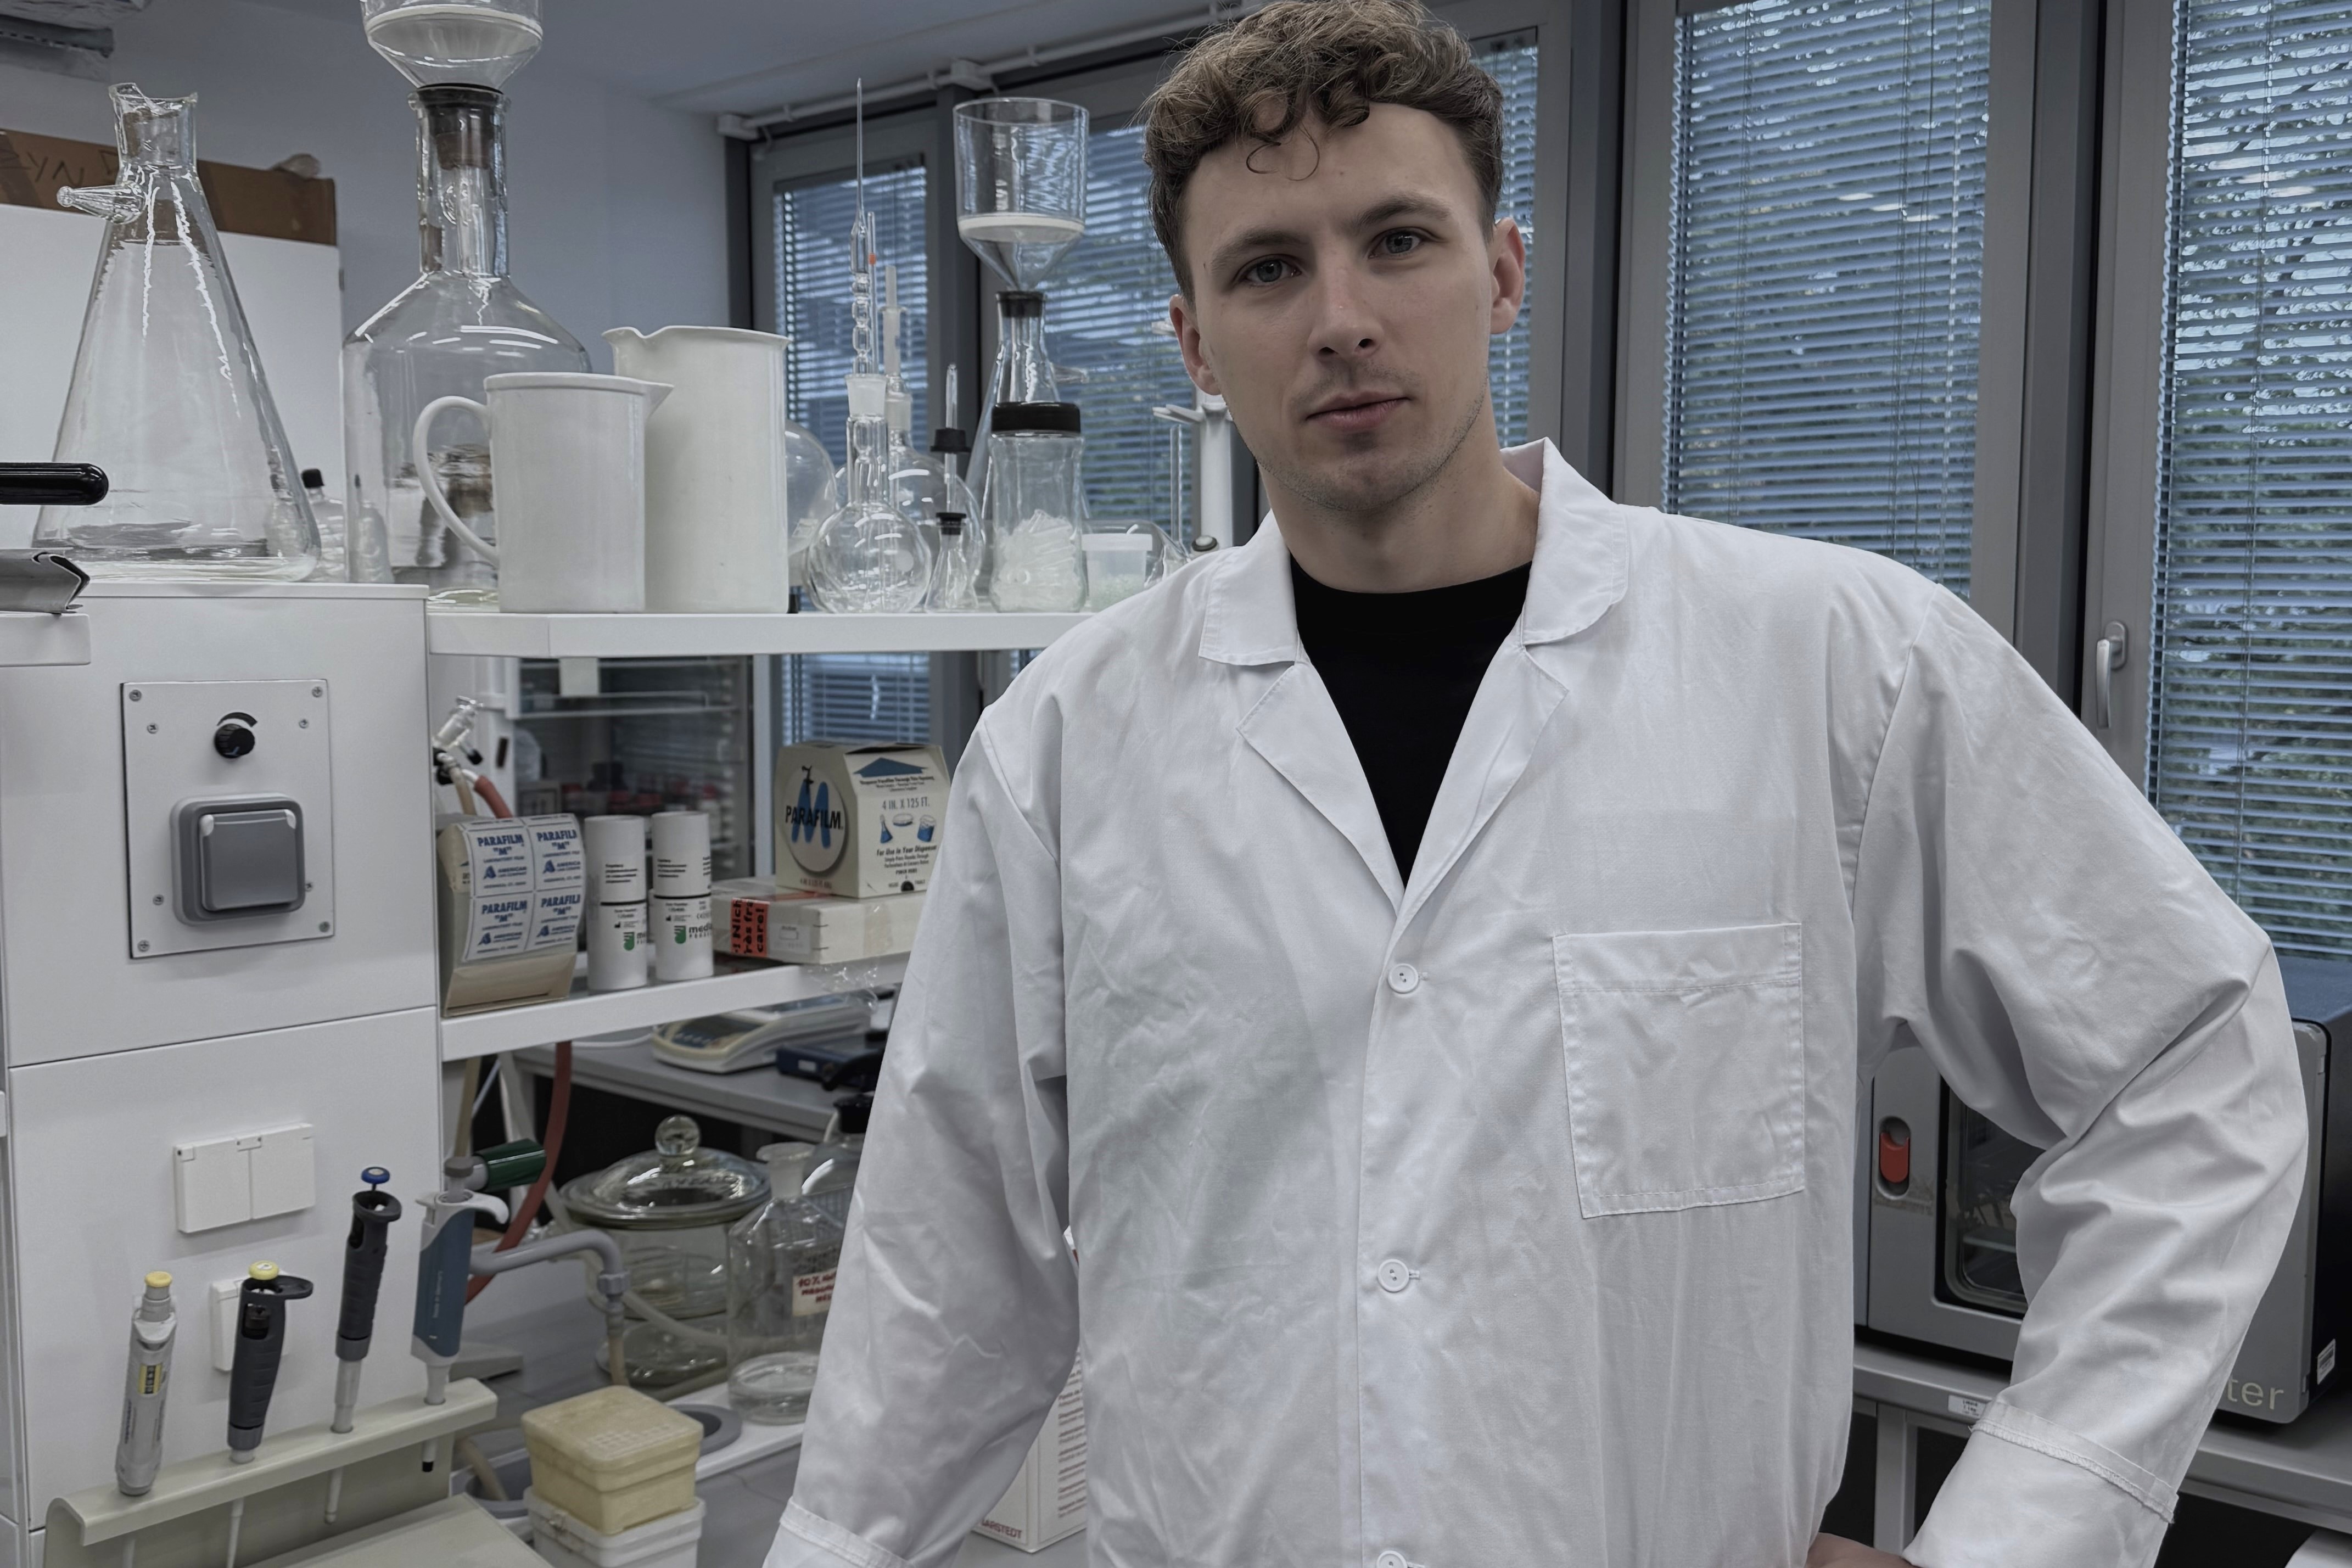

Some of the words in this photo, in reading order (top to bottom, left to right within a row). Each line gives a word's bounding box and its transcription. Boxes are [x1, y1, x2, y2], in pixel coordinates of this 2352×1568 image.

[882, 800, 887, 810] 4
[888, 800, 898, 810] IN.
[900, 799, 905, 809] X
[907, 798, 919, 808] 125
[921, 797, 930, 807] FT.
[785, 805, 841, 830] PARAFILM
[477, 834, 524, 847] PARAFILM
[493, 846, 512, 855] "M"
[481, 900, 528, 914] PARAFILM
[743, 927, 753, 954] rès
